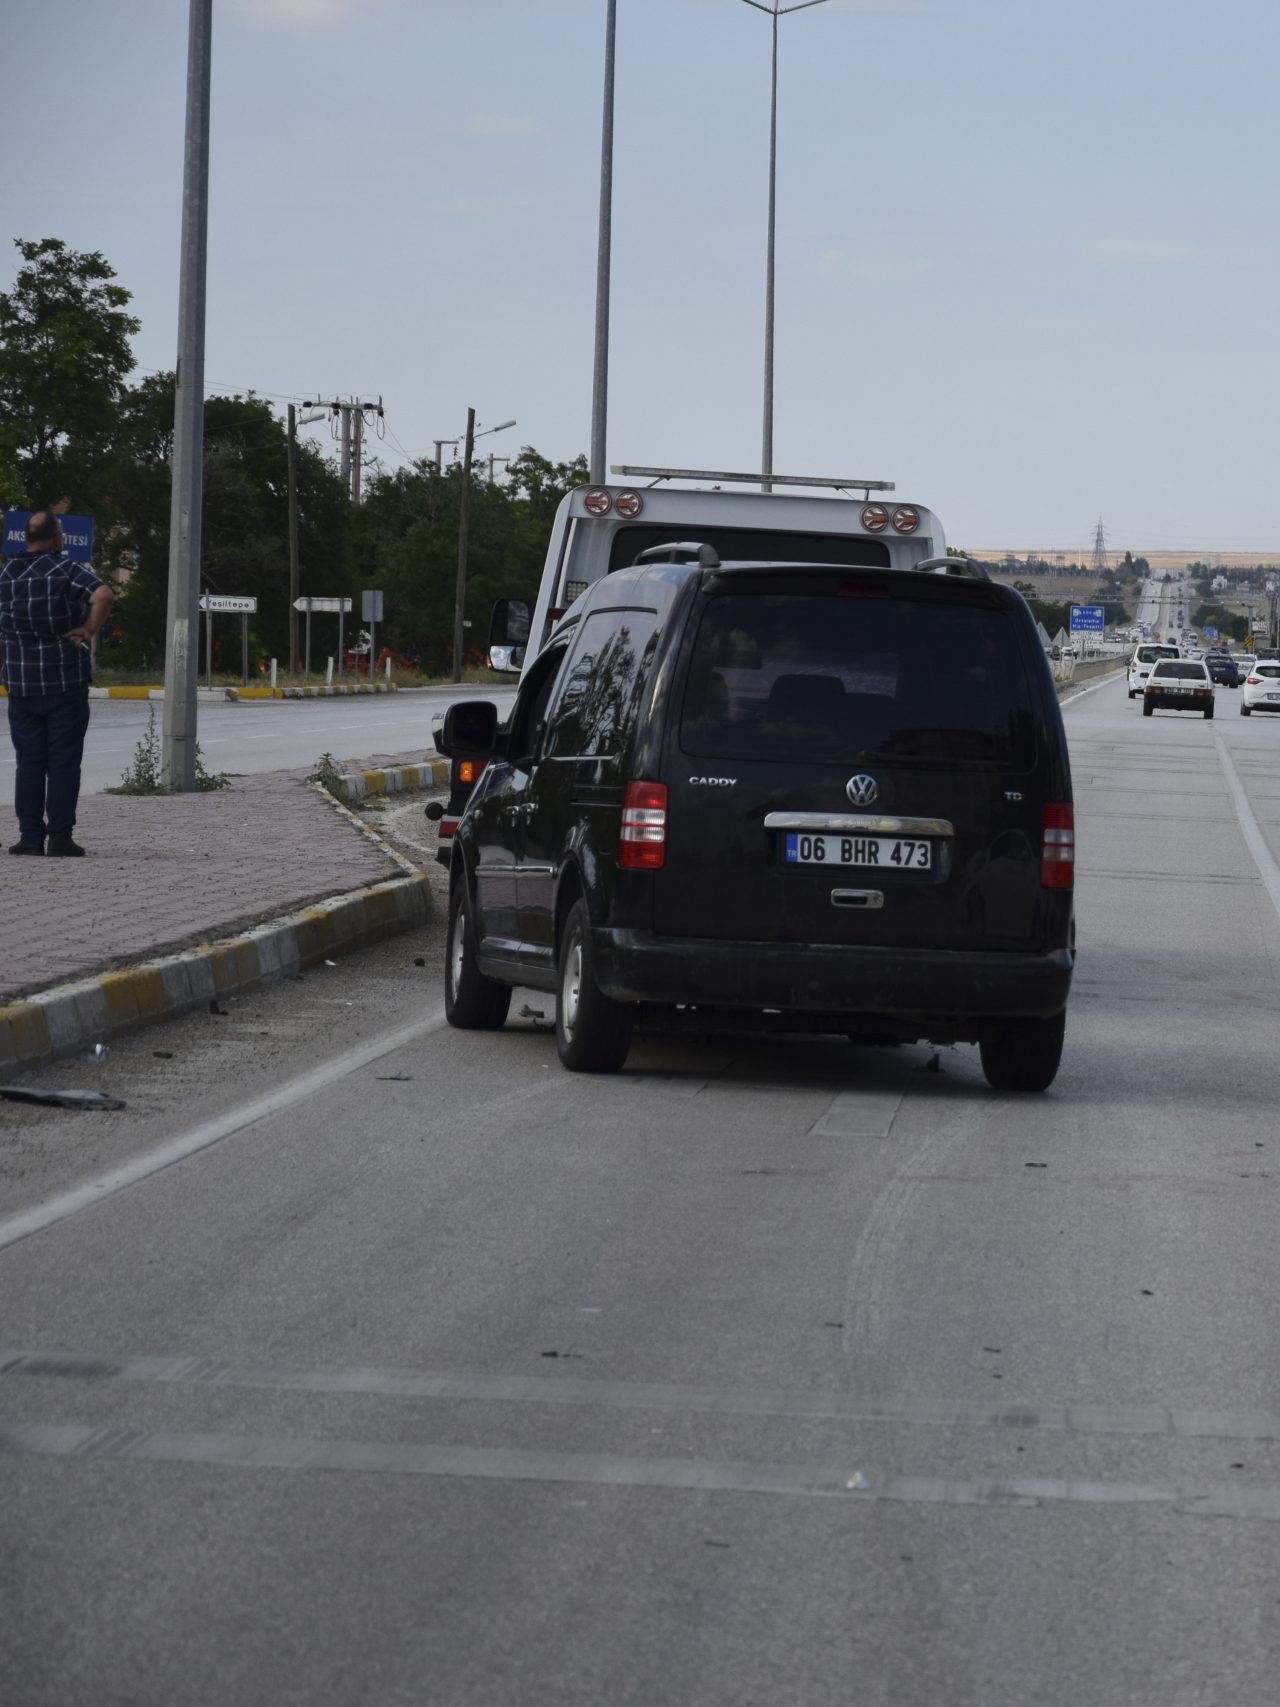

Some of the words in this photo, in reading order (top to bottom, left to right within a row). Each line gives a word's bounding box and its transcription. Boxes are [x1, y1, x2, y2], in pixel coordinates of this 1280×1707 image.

[689, 776, 738, 786] CADDY
[800, 836, 826, 861] 06
[840, 838, 880, 864] BHR
[890, 841, 929, 867] 473
